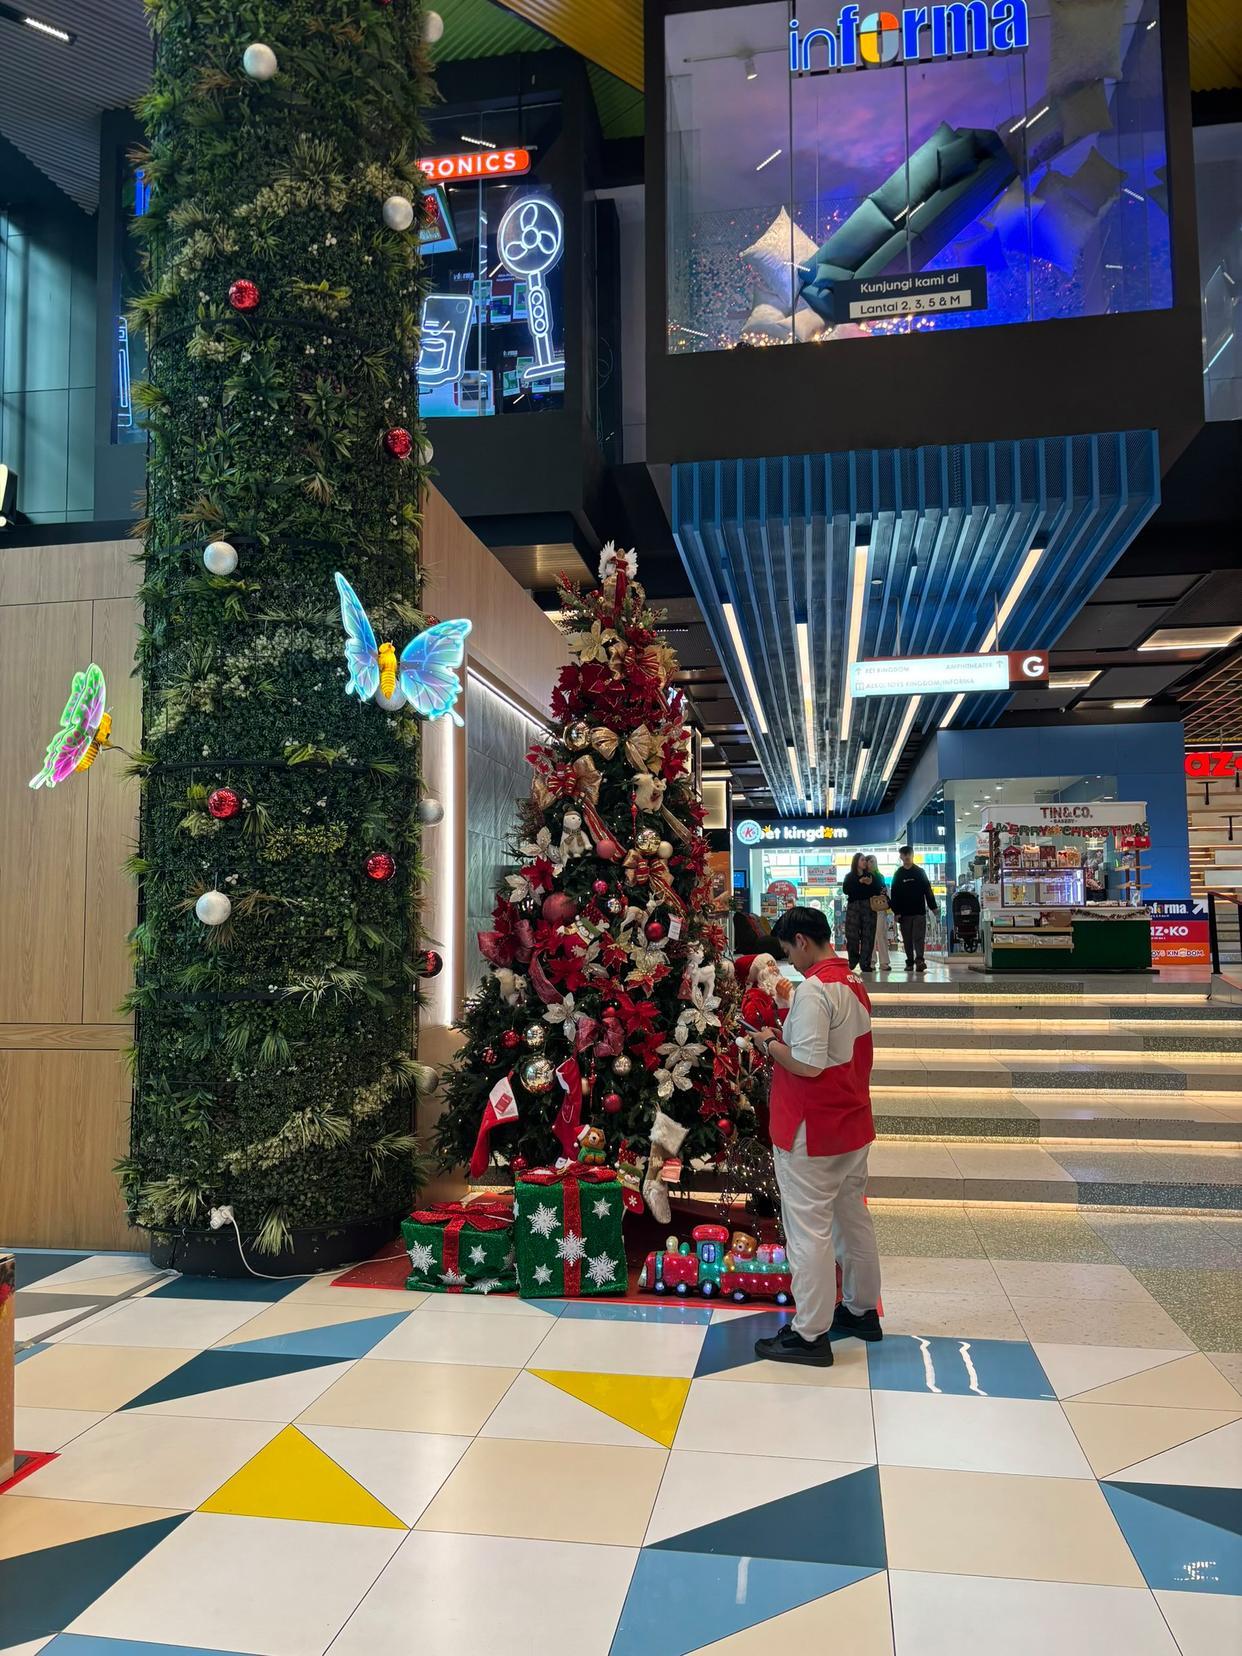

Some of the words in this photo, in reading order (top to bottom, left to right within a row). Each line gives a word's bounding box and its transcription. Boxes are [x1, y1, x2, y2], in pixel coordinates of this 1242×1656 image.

[789, 0, 1029, 71] informa
[860, 280, 912, 293] Kunjungi
[915, 274, 944, 287] kami
[947, 273, 960, 284] di
[860, 302, 899, 315] Lantai
[901, 301, 911, 311] 2,
[915, 299, 925, 310] 3,
[928, 298, 936, 308] 5
[939, 297, 947, 306] &
[950, 295, 961, 305] M
[1022, 656, 1045, 677] G
[996, 822, 1048, 837] MERRY
[1062, 821, 1151, 838] CHRISTMAS
